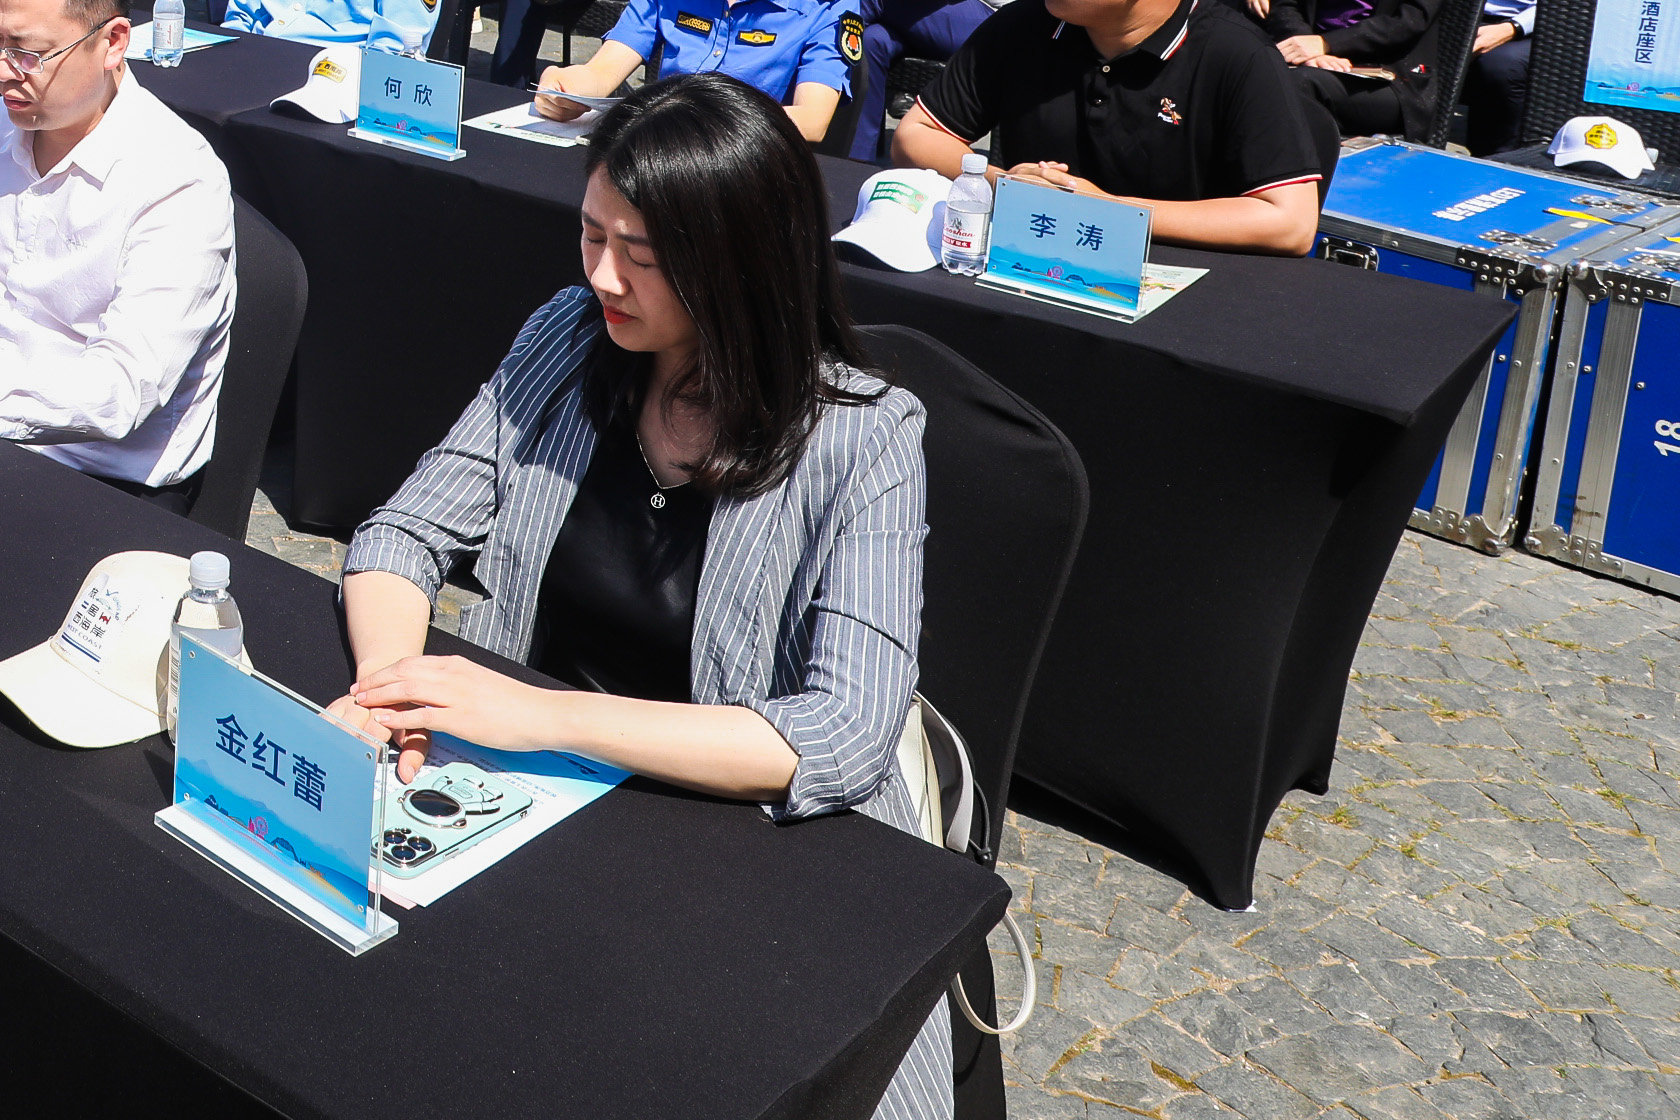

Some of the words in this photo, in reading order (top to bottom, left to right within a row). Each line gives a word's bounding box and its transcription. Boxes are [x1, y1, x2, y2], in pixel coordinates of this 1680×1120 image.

[1634, 0, 1661, 64] 酒店座区
[384, 77, 433, 107] 何欣
[1029, 213, 1104, 251] 李涛
[215, 714, 327, 812] 金红蕾
